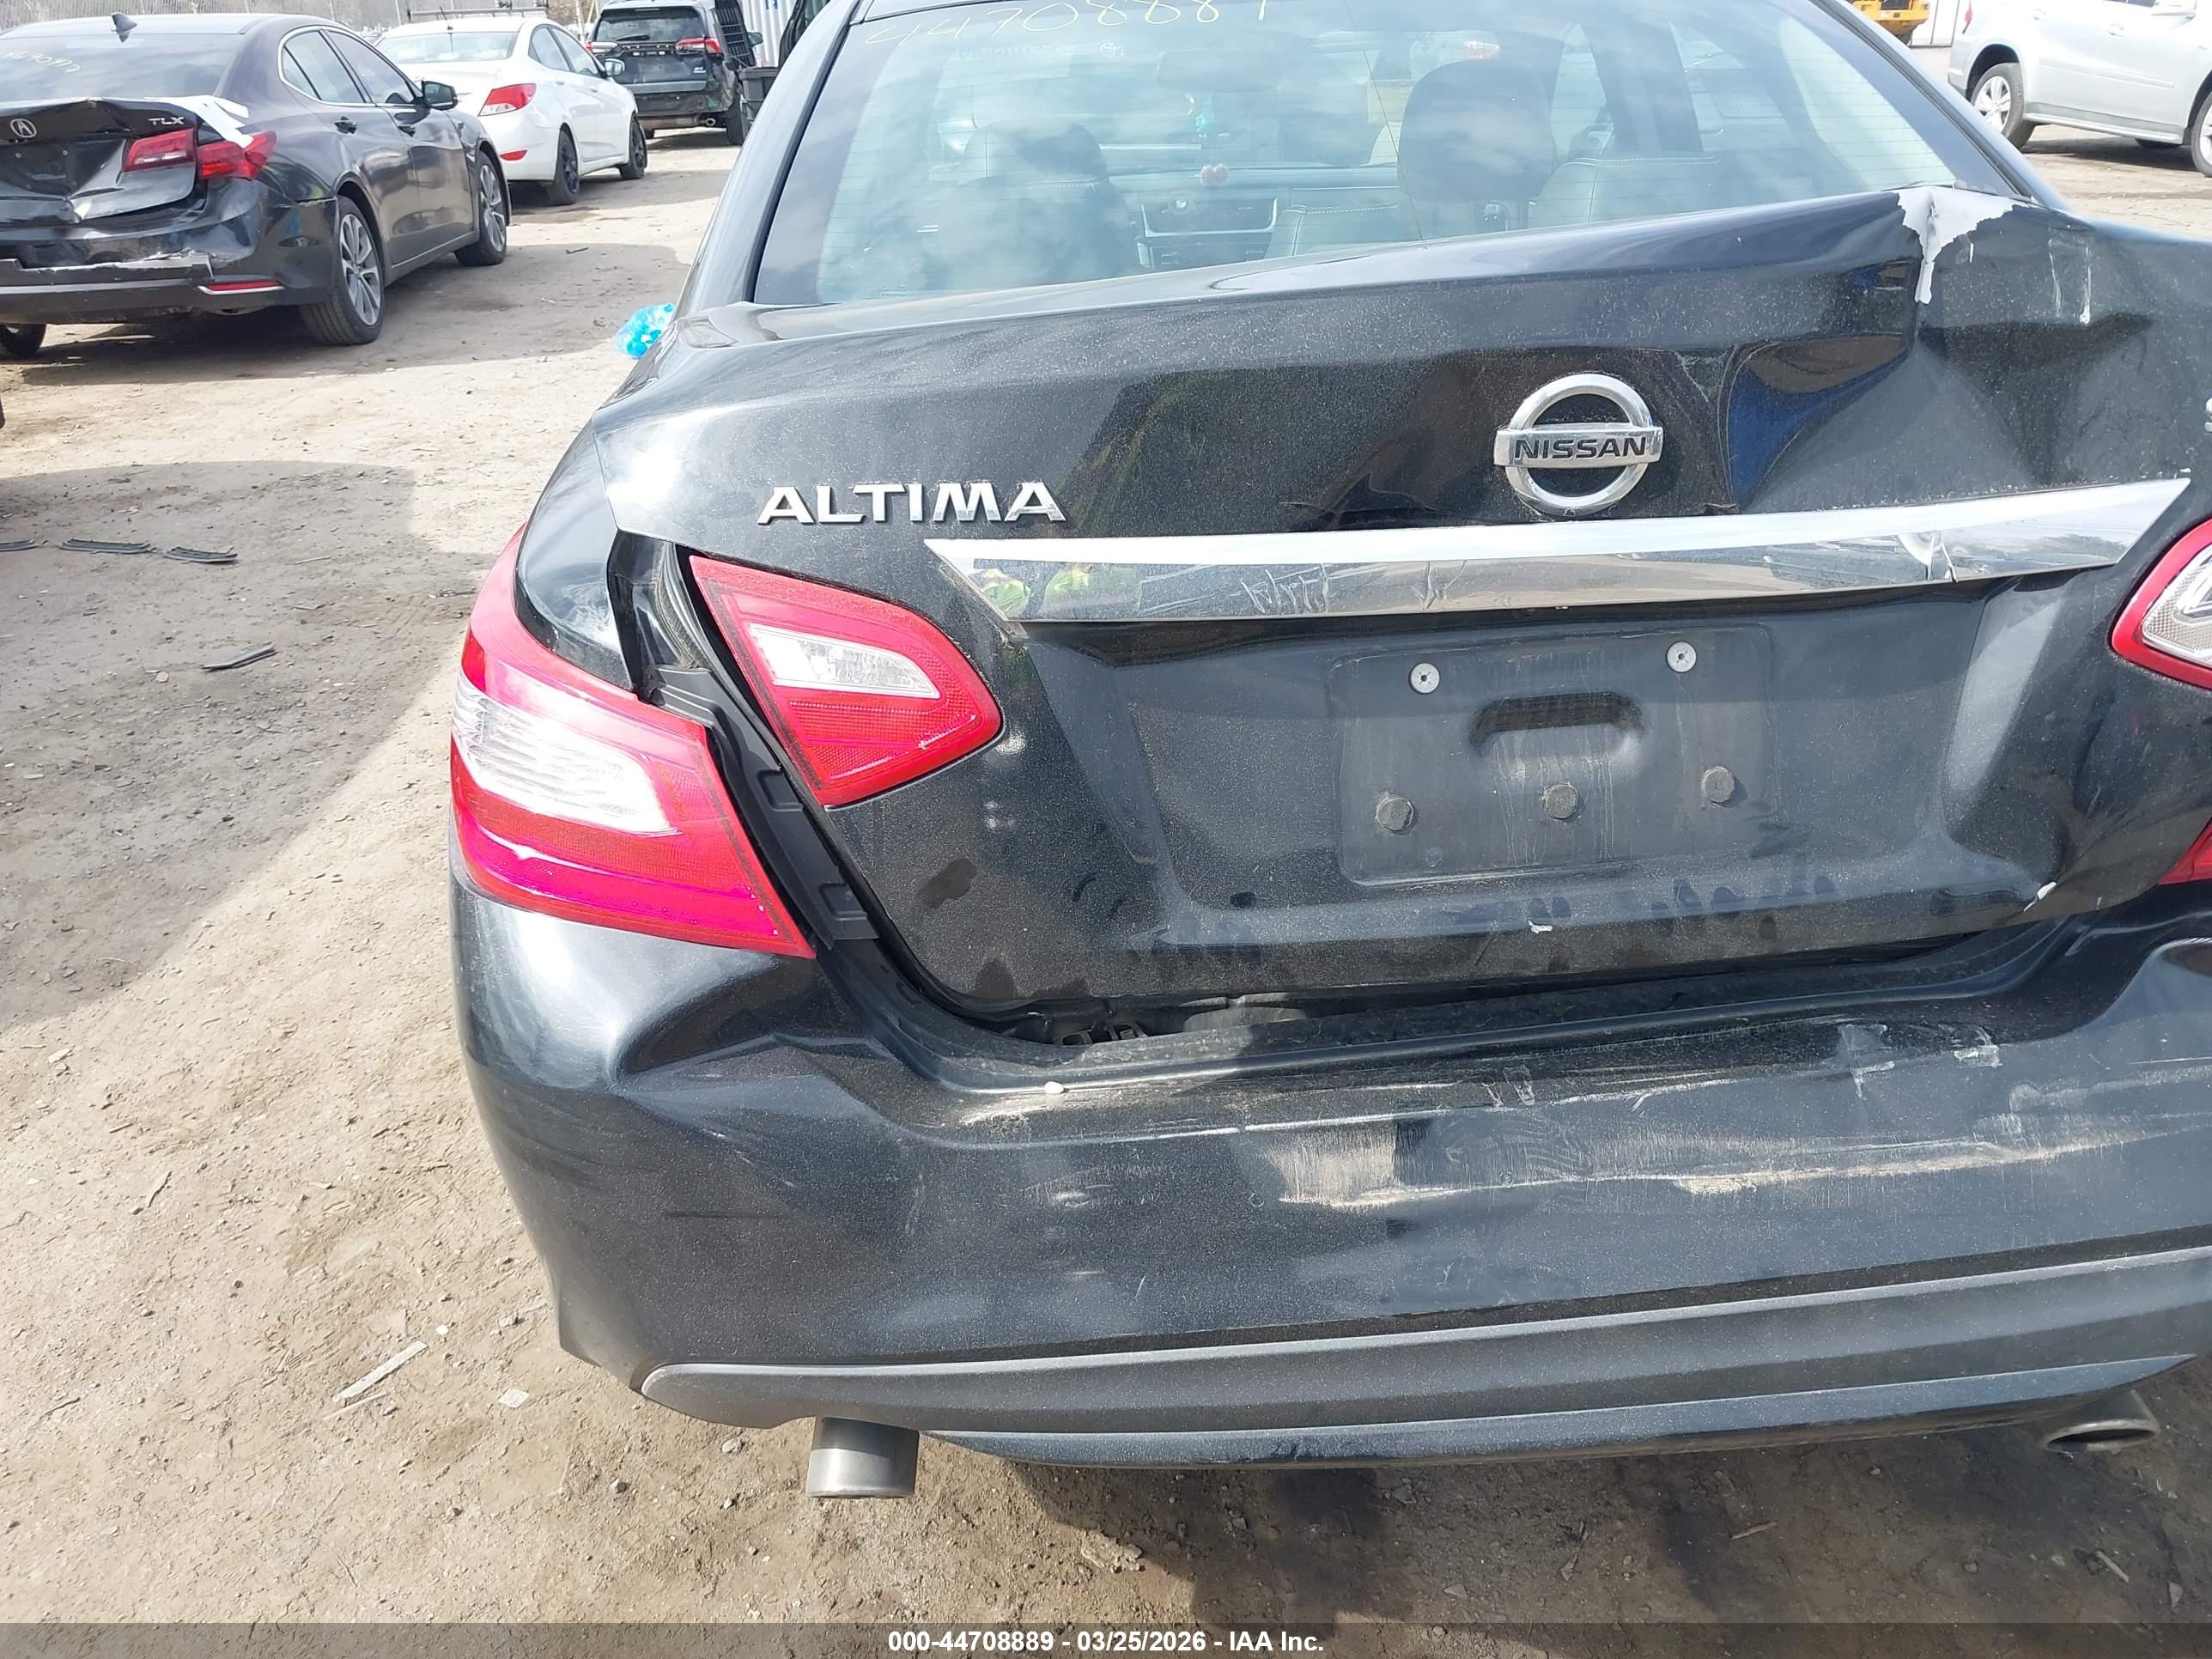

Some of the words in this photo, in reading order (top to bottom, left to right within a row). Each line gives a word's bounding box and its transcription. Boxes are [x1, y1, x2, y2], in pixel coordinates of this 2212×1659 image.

[865, 0, 1267, 46] 4470888
[147, 116, 185, 126] TLX
[1514, 436, 1647, 459] NISSAN
[757, 481, 1067, 526] ALTIMA
